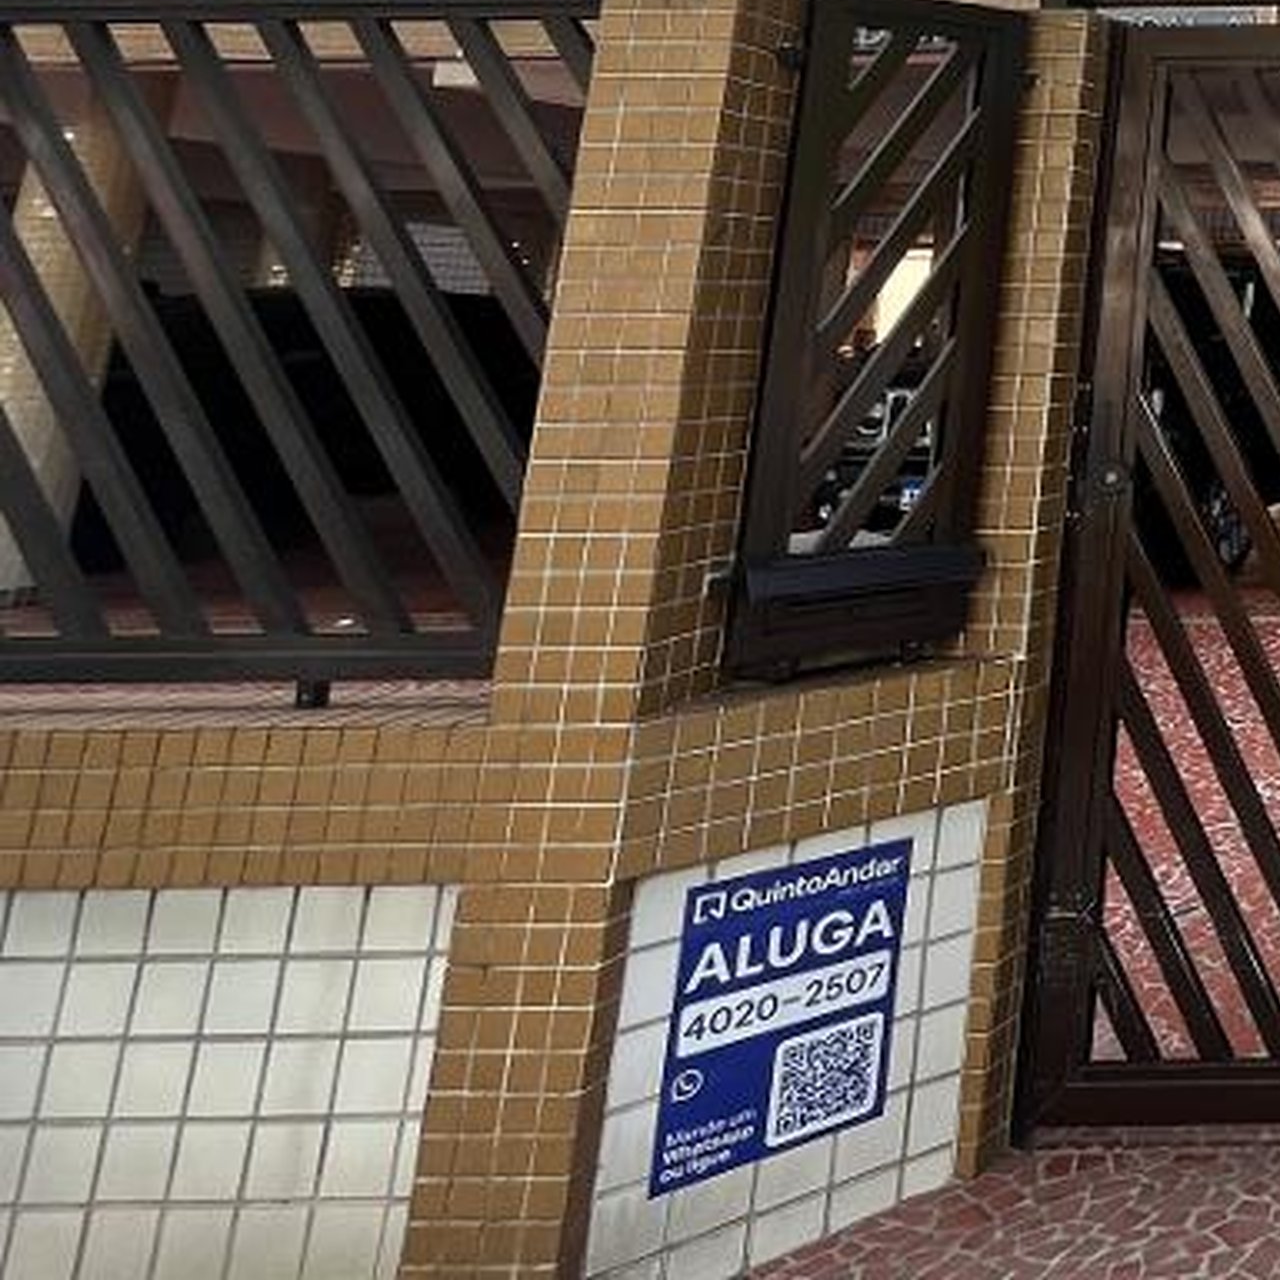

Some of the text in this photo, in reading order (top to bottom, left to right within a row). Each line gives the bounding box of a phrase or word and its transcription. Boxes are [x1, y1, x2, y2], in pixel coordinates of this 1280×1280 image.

[731, 857, 903, 911] QuintoAndar
[684, 899, 894, 995] ALUGA
[683, 963, 884, 1041] 4020-2507
